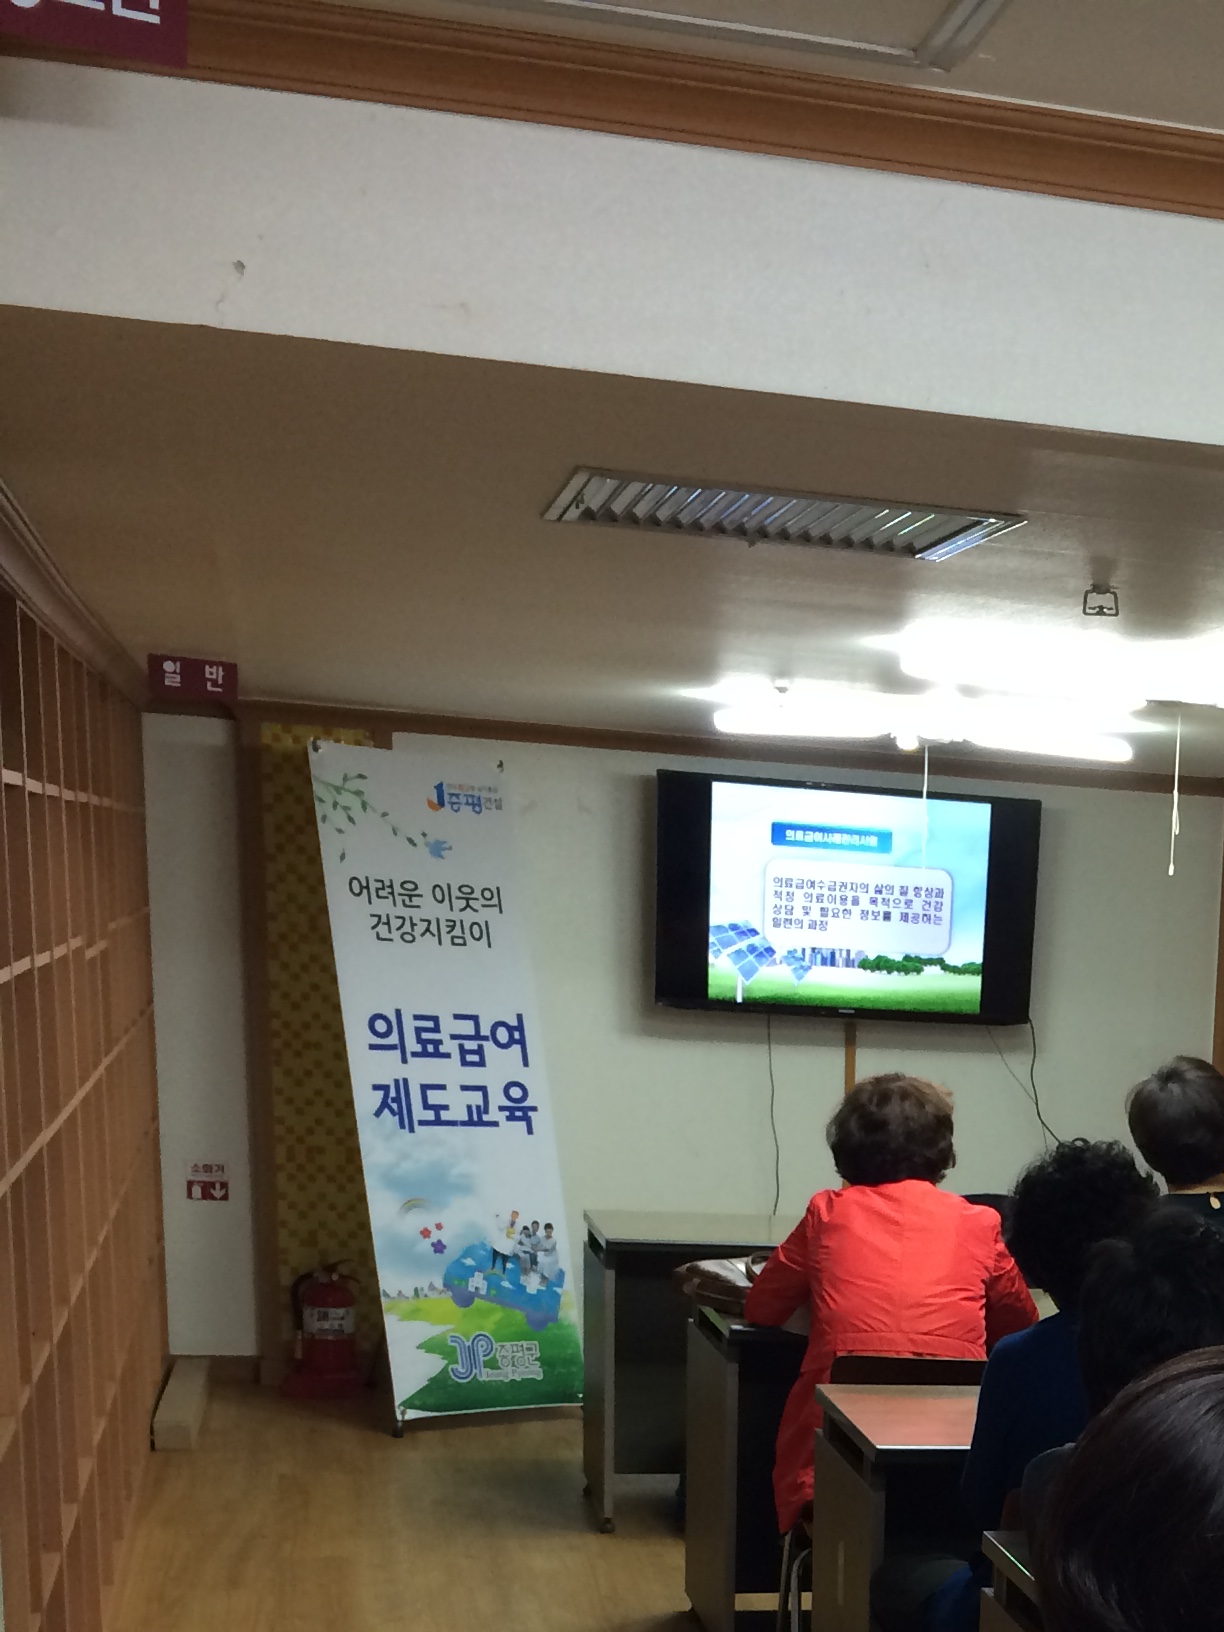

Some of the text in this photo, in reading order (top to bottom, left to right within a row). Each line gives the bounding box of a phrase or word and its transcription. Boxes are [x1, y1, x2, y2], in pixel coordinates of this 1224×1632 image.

[348, 876, 503, 914] 어려운 이웃의
[773, 877, 869, 894] 의료급여수급권자의
[874, 883, 895, 896] 삶의
[772, 903, 795, 916] 상담
[820, 906, 852, 919] 필요한
[860, 909, 892, 923] 정보를
[900, 911, 944, 926] 제공하는
[773, 890, 944, 913] 적정 의료이용을 목적으로 건강
[369, 913, 492, 949] 건강지킴이
[772, 917, 829, 932] 일련의 과정
[367, 1008, 530, 1068] 의료급여
[371, 1078, 539, 1136] 제도교육
